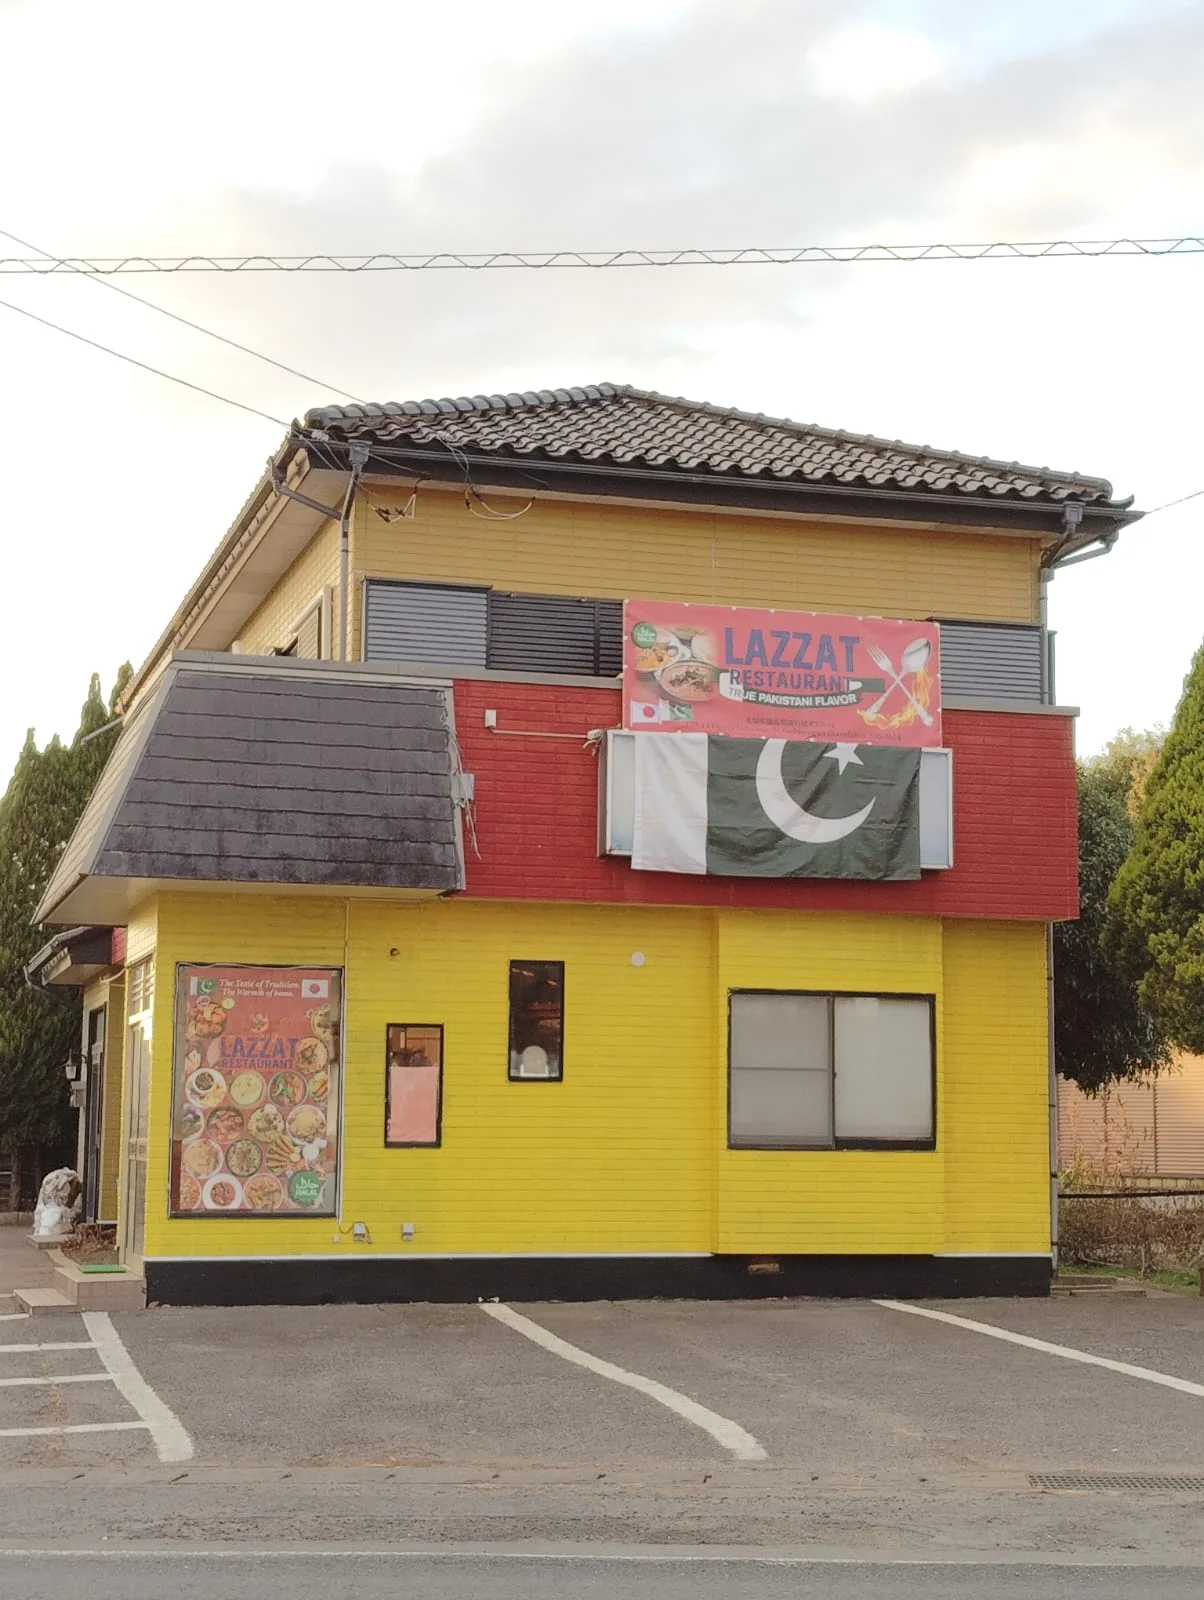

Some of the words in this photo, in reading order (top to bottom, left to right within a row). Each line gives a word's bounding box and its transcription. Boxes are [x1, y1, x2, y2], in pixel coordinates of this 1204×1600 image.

[724, 627, 860, 673] LAZZAT
[729, 669, 850, 693] RESTAURANT
[758, 692, 813, 707] PAKISTANI
[815, 693, 857, 707] FLAVOR
[221, 1036, 299, 1058] LAZZAT
[221, 1058, 293, 1069] RESTAURANT
